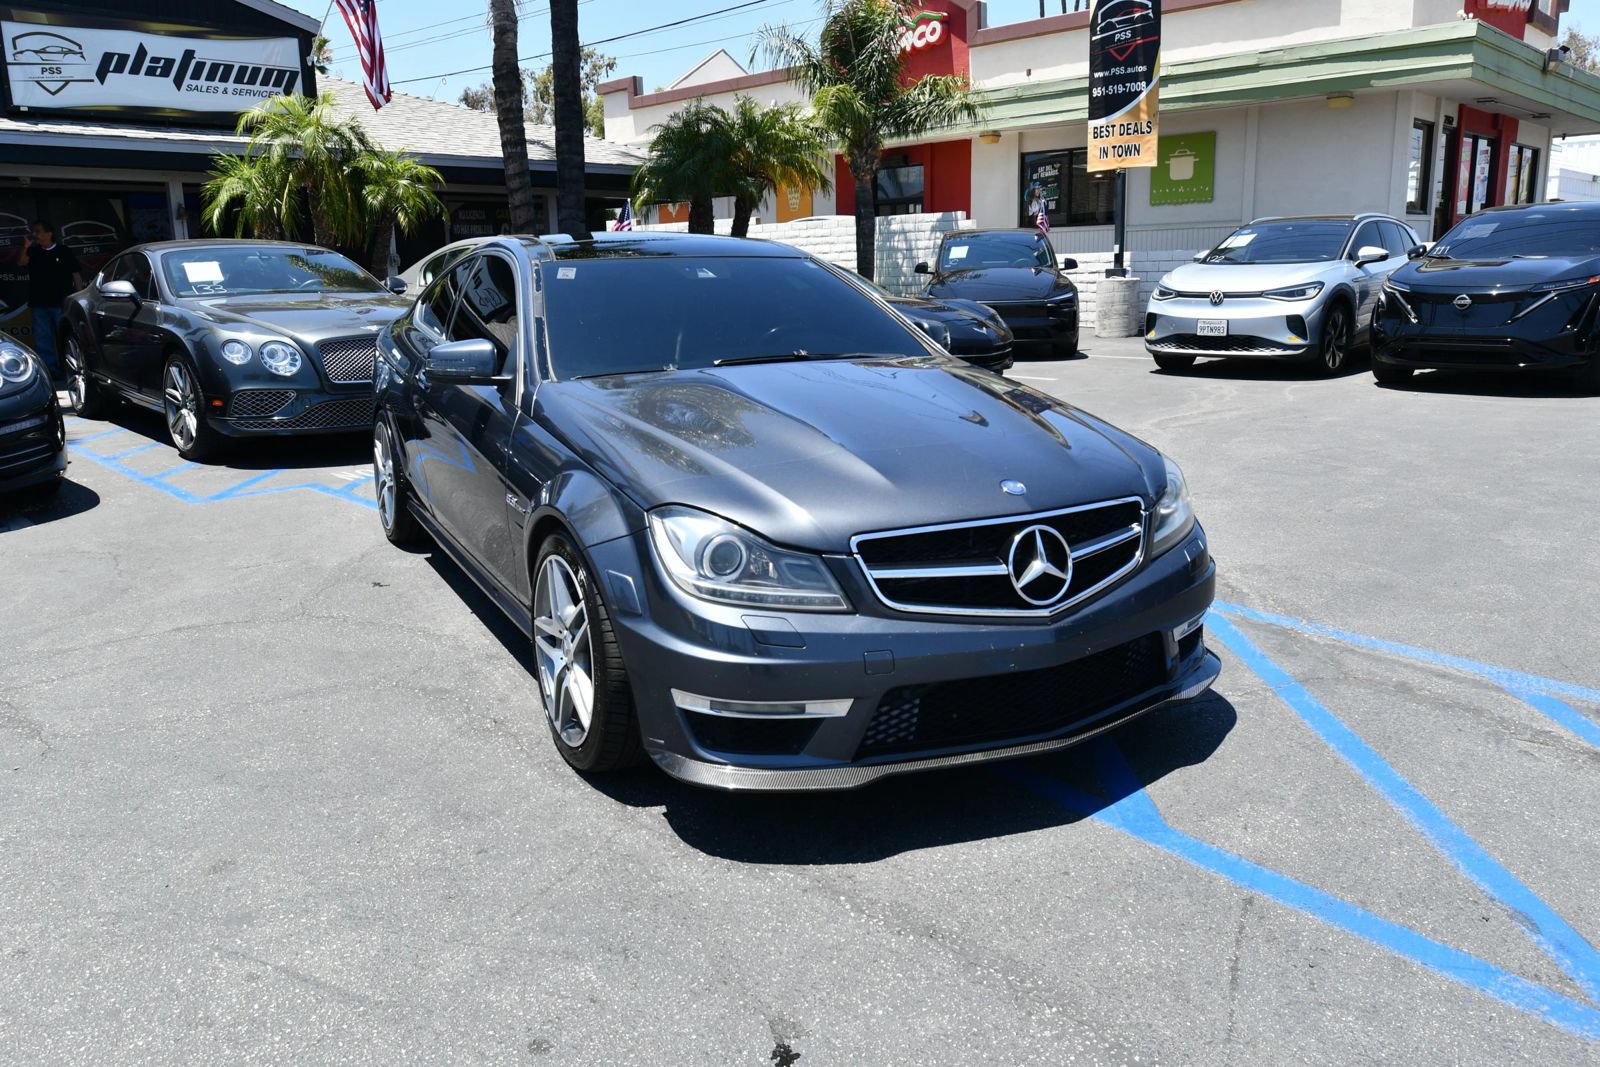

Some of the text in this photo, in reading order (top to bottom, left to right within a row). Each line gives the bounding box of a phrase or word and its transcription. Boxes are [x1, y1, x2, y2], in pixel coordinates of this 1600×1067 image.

[1114, 30, 1132, 42] PSS
[40, 66, 63, 75] PSS
[95, 42, 299, 96] platinum
[1093, 64, 1147, 79] www.PSS.autos
[185, 83, 281, 98] SALES & SERVICES
[1092, 81, 1147, 97] 951-519-7008
[1093, 120, 1153, 139] BEST DEALS
[1099, 144, 1141, 159] IN TOWN
[191, 284, 228, 296] 133
